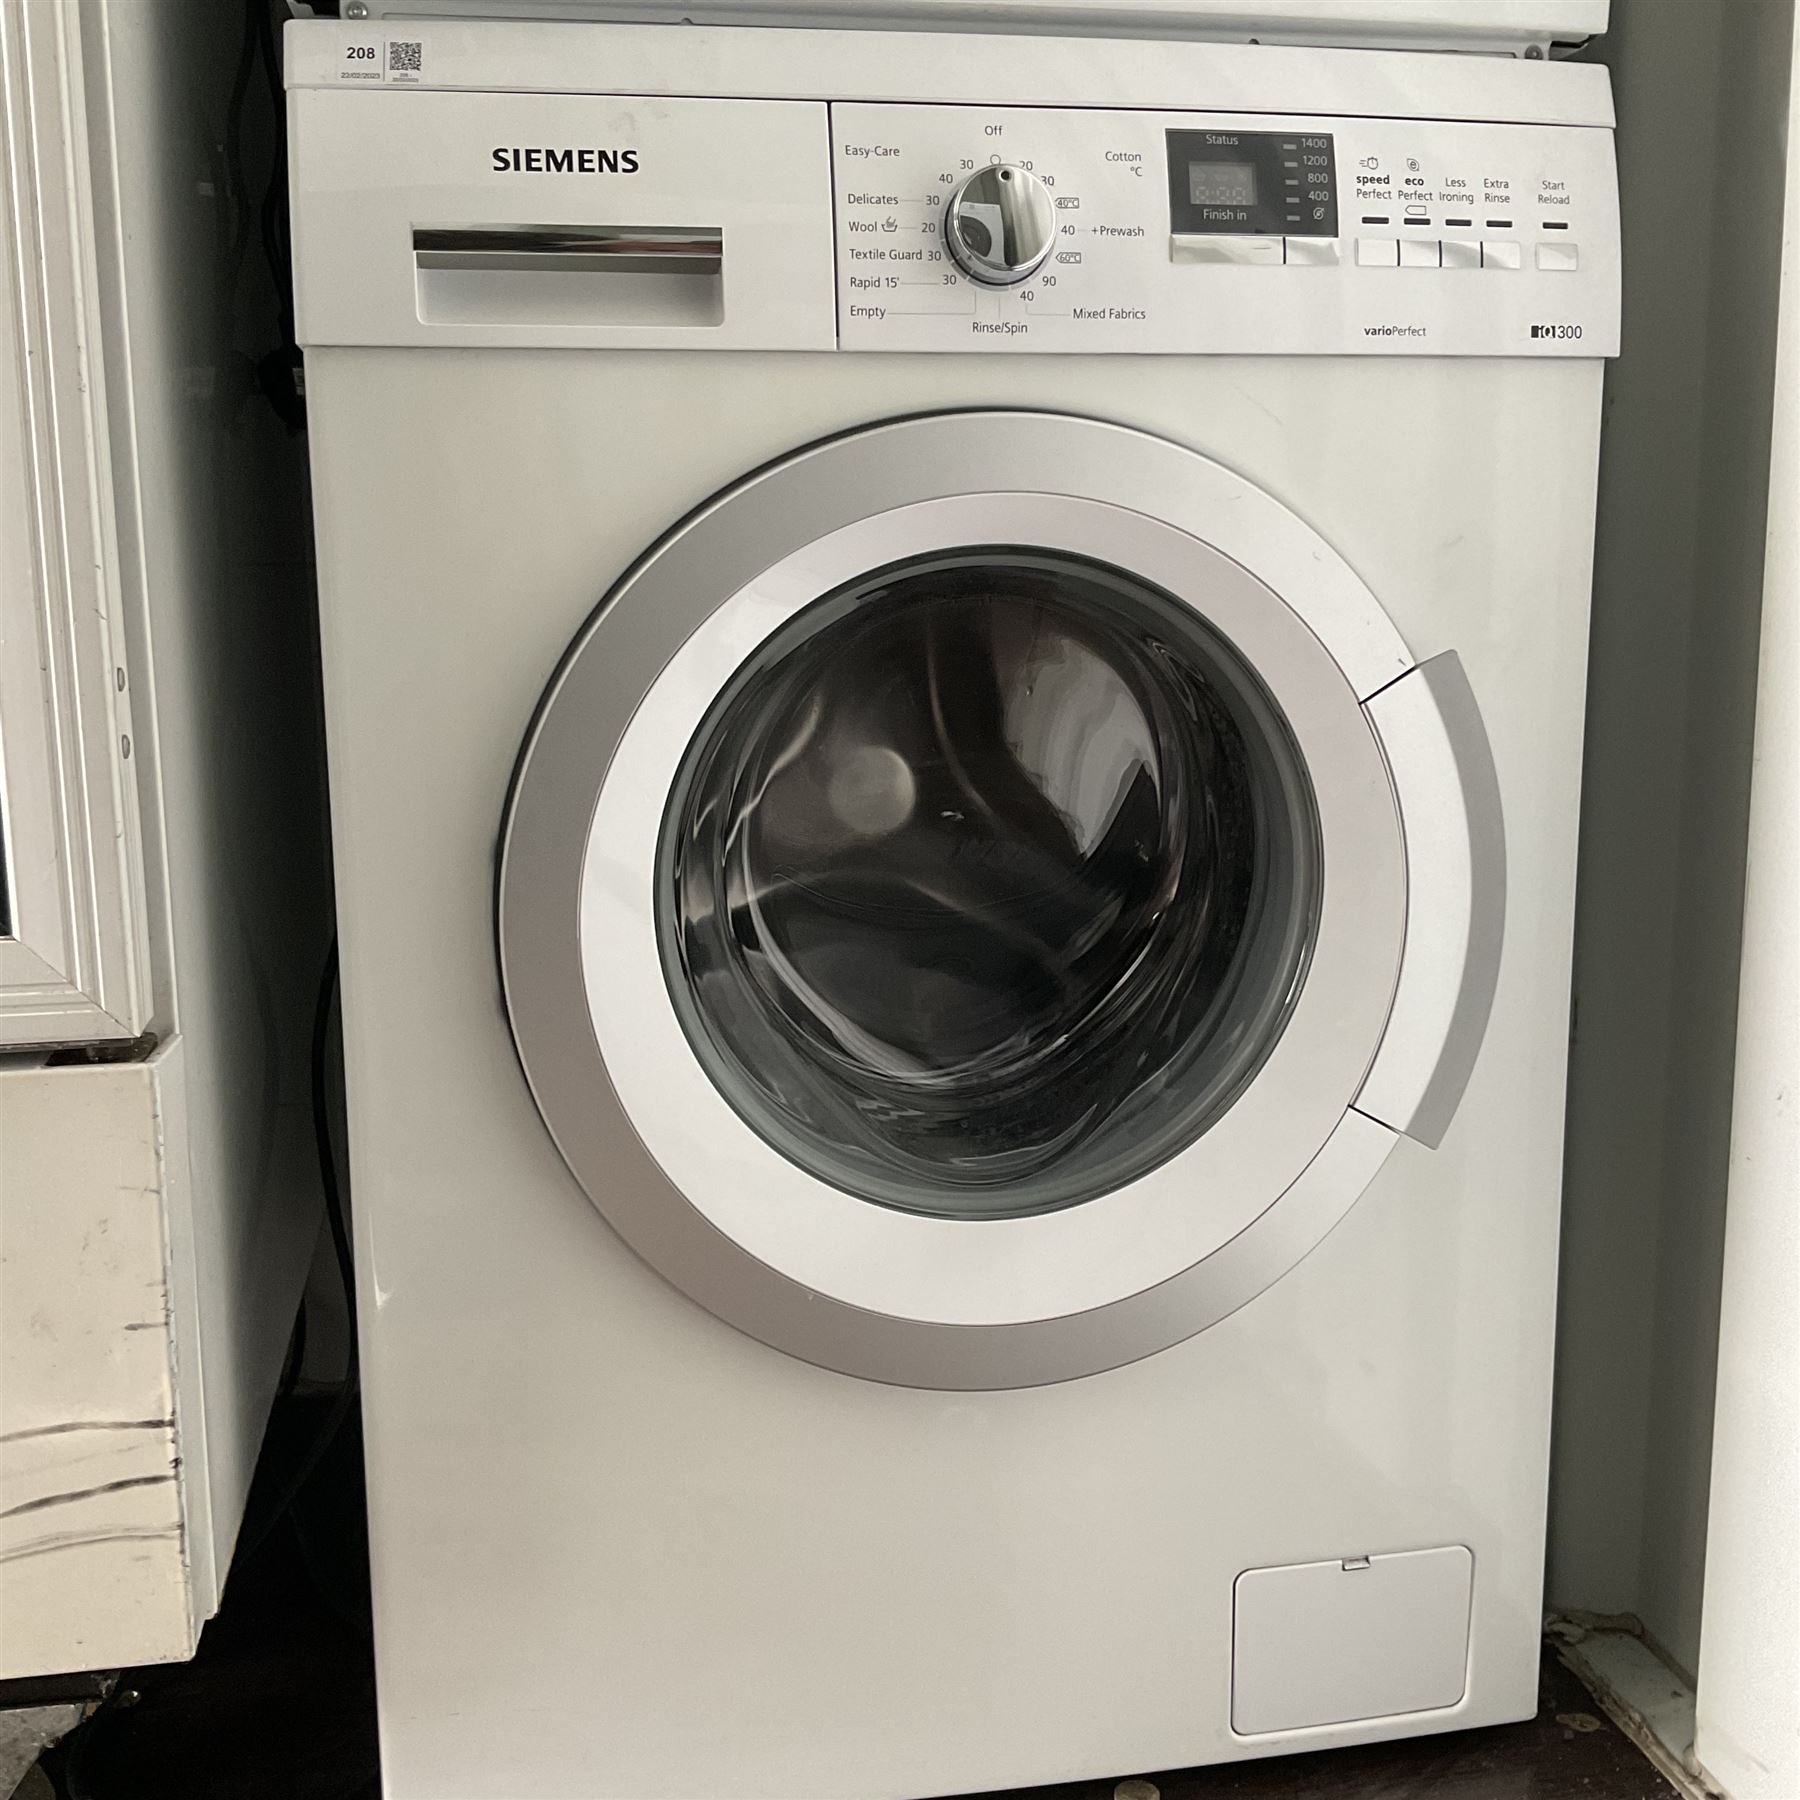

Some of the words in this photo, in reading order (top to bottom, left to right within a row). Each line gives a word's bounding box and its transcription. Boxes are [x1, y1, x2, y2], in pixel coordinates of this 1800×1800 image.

[347, 47, 375, 59] 208
[985, 125, 1002, 136] Off
[1206, 134, 1238, 145] Status
[1301, 138, 1327, 148] 1400
[845, 145, 900, 158] Easy-Care
[1105, 151, 1141, 161] Cotton
[492, 148, 639, 173] SIEMENS
[960, 159, 973, 169] 30
[1303, 155, 1327, 166] 1200
[1130, 167, 1142, 177] °C
[939, 174, 953, 184] 40
[1308, 173, 1328, 183] 800
[1356, 175, 1390, 186] speed
[1405, 178, 1424, 186] eco
[1445, 178, 1466, 187] Less
[1484, 178, 1509, 189] Extra
[1542, 180, 1565, 190] Start
[1308, 191, 1329, 201] 400
[1357, 188, 1392, 199] Perfect
[1398, 190, 1433, 201] Perfect
[1439, 192, 1474, 205] Ironing
[1485, 193, 1510, 203] Rinse
[848, 194, 898, 205] Delicates
[926, 195, 940, 205] 30
[1538, 195, 1570, 204] Reload
[1204, 209, 1234, 220] Finish
[1237, 210, 1246, 220] in
[849, 221, 877, 232] Wool
[921, 222, 936, 234] 20
[1061, 225, 1075, 235] 40
[849, 249, 885, 260] Textile
[889, 249, 922, 260] Guard
[928, 251, 941, 261] 30
[850, 277, 880, 290] Rapid
[942, 274, 957, 285] 30
[1042, 276, 1056, 286] 90
[1020, 291, 1034, 301] 40
[851, 305, 886, 319] Empty
[1073, 308, 1105, 319] Mixed
[1109, 308, 1146, 319] Fabrics
[973, 322, 1027, 335] Rinse/Spin
[1364, 326, 1426, 336] varioPerfect
